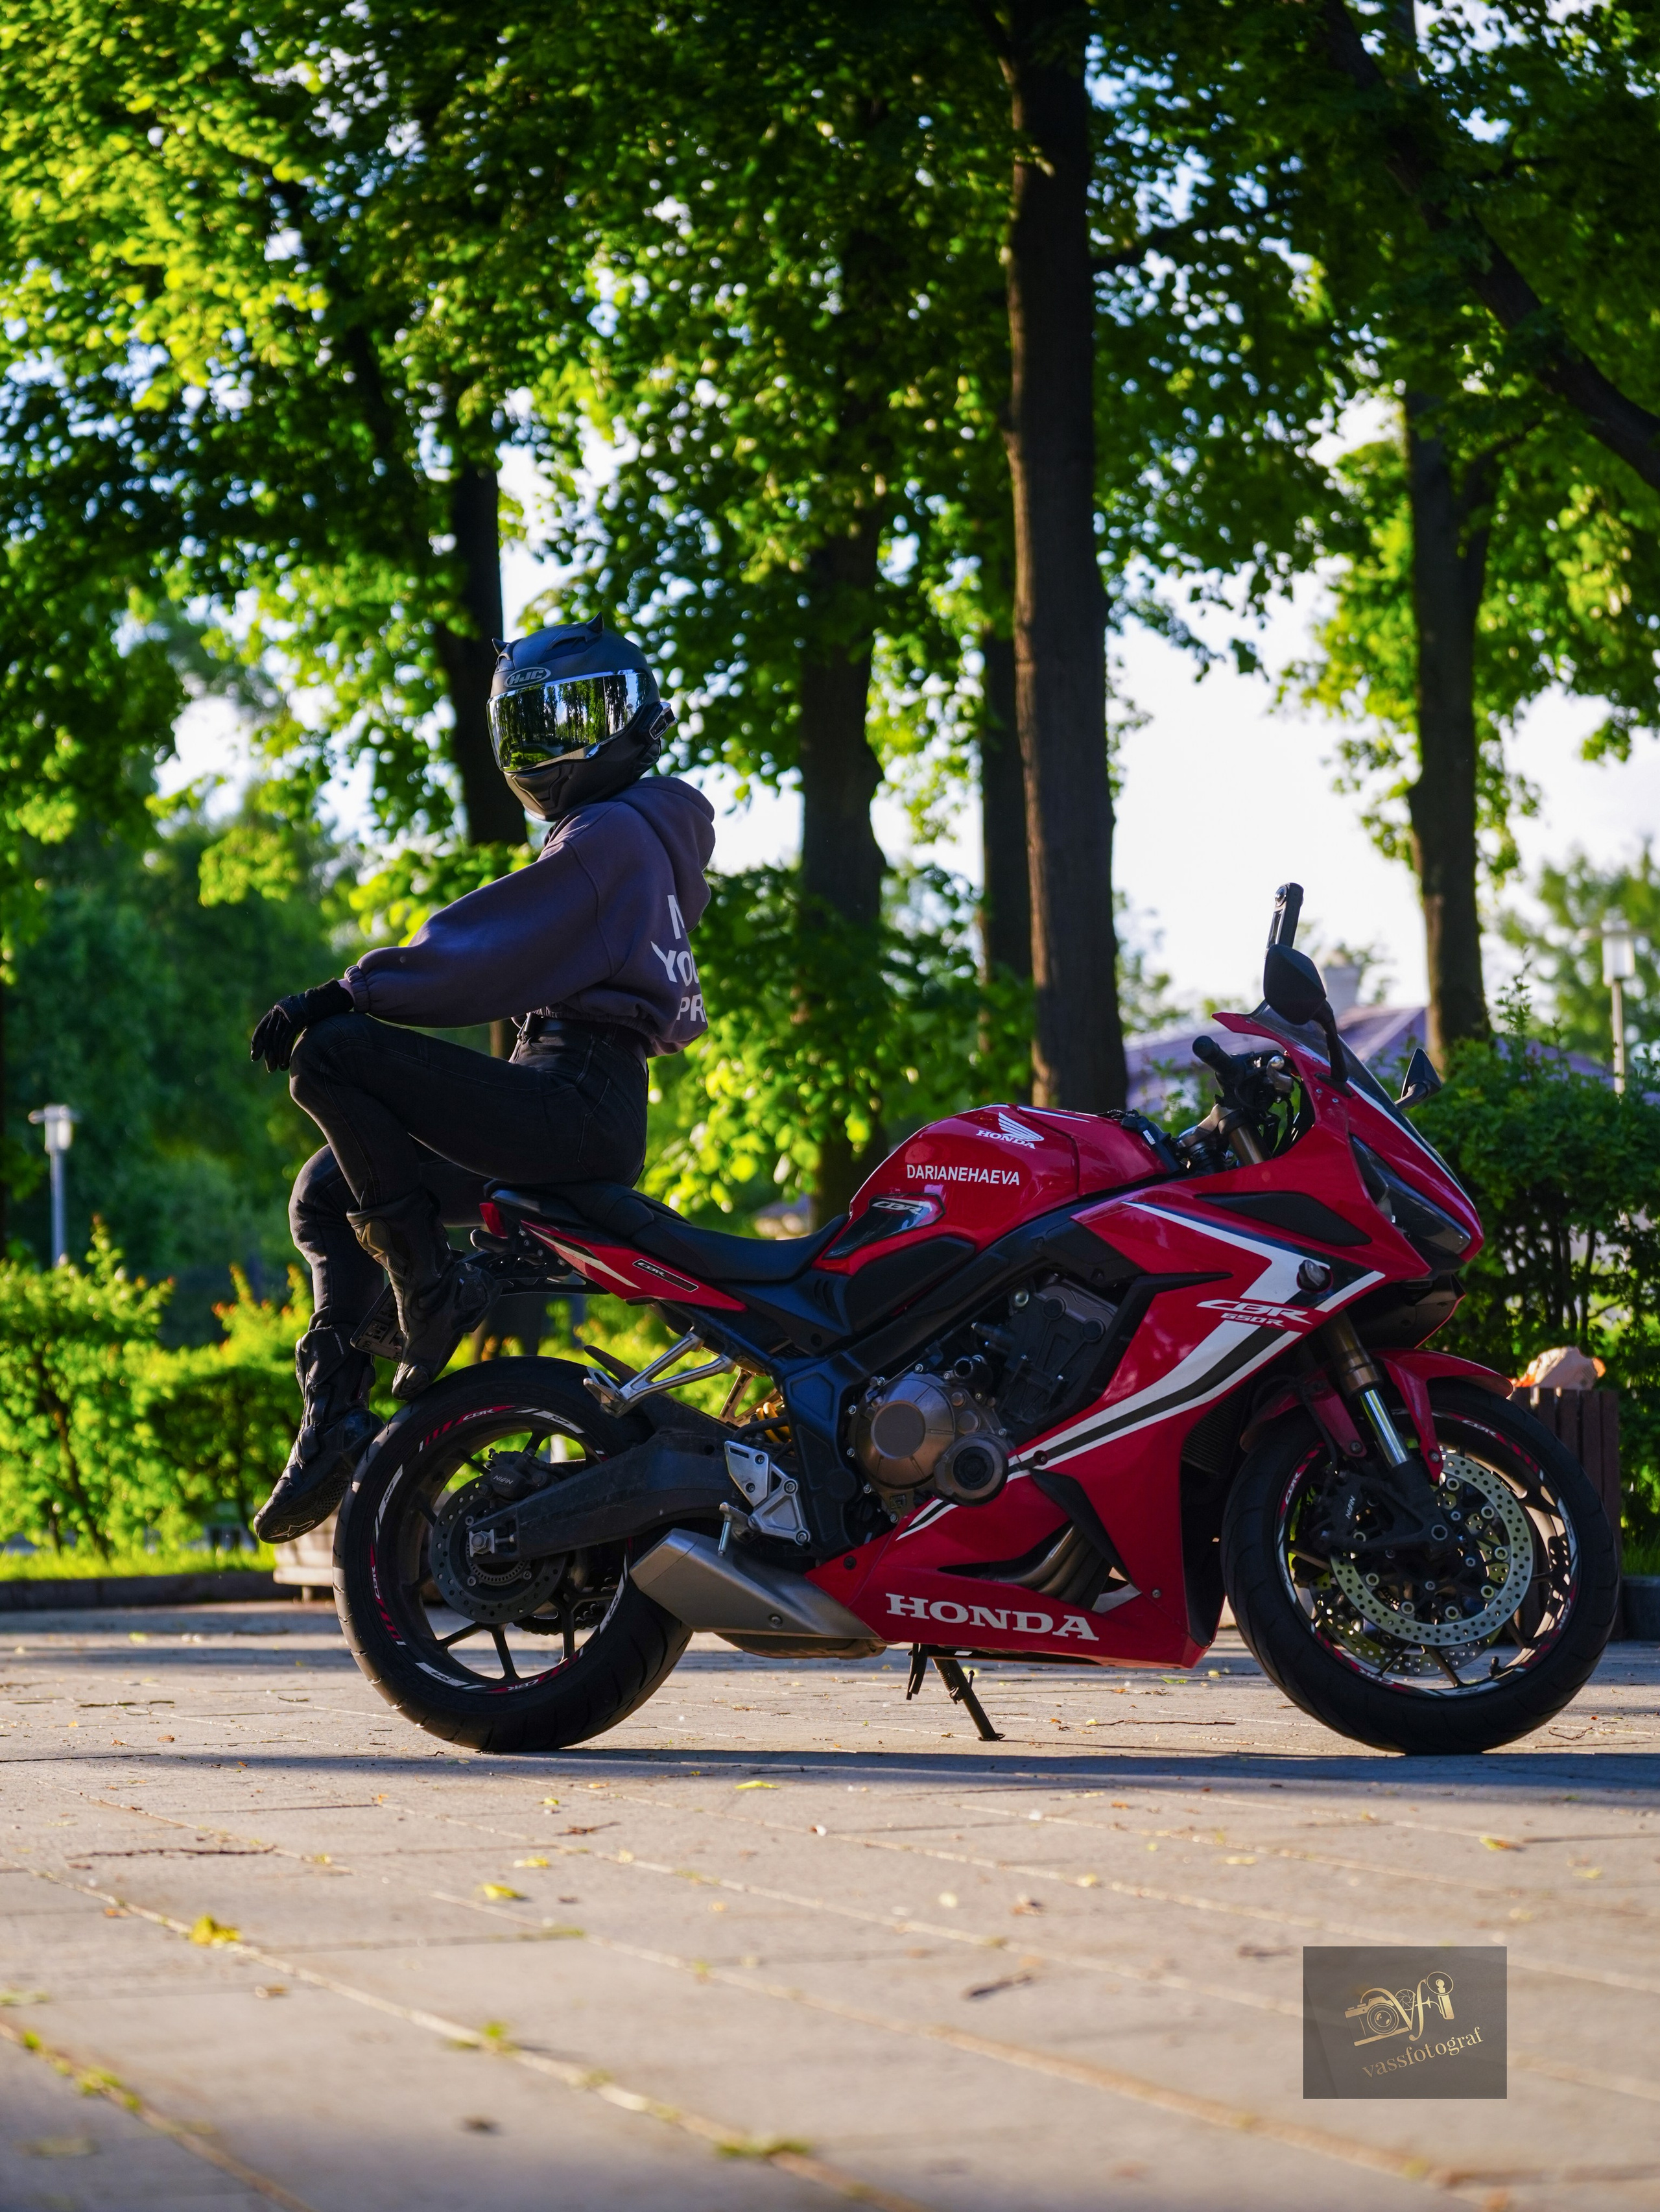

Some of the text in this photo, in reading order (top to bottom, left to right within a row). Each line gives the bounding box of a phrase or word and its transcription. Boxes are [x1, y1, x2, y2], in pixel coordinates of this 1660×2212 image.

[509, 669, 545, 685] HJC
[976, 1130, 1036, 1150] HONDA
[907, 1164, 1021, 1186] DARIANEHAEVA
[637, 1262, 666, 1278] CBR
[1196, 1299, 1313, 1325] CBR
[1220, 1313, 1285, 1327] 650R
[462, 1408, 495, 1421] CBR
[1462, 1420, 1498, 1438] CBR
[1285, 1472, 1303, 1505] CBR
[372, 1564, 381, 1600] CBR
[885, 1593, 1100, 1641] HONDA
[506, 1678, 540, 1691] CBR
